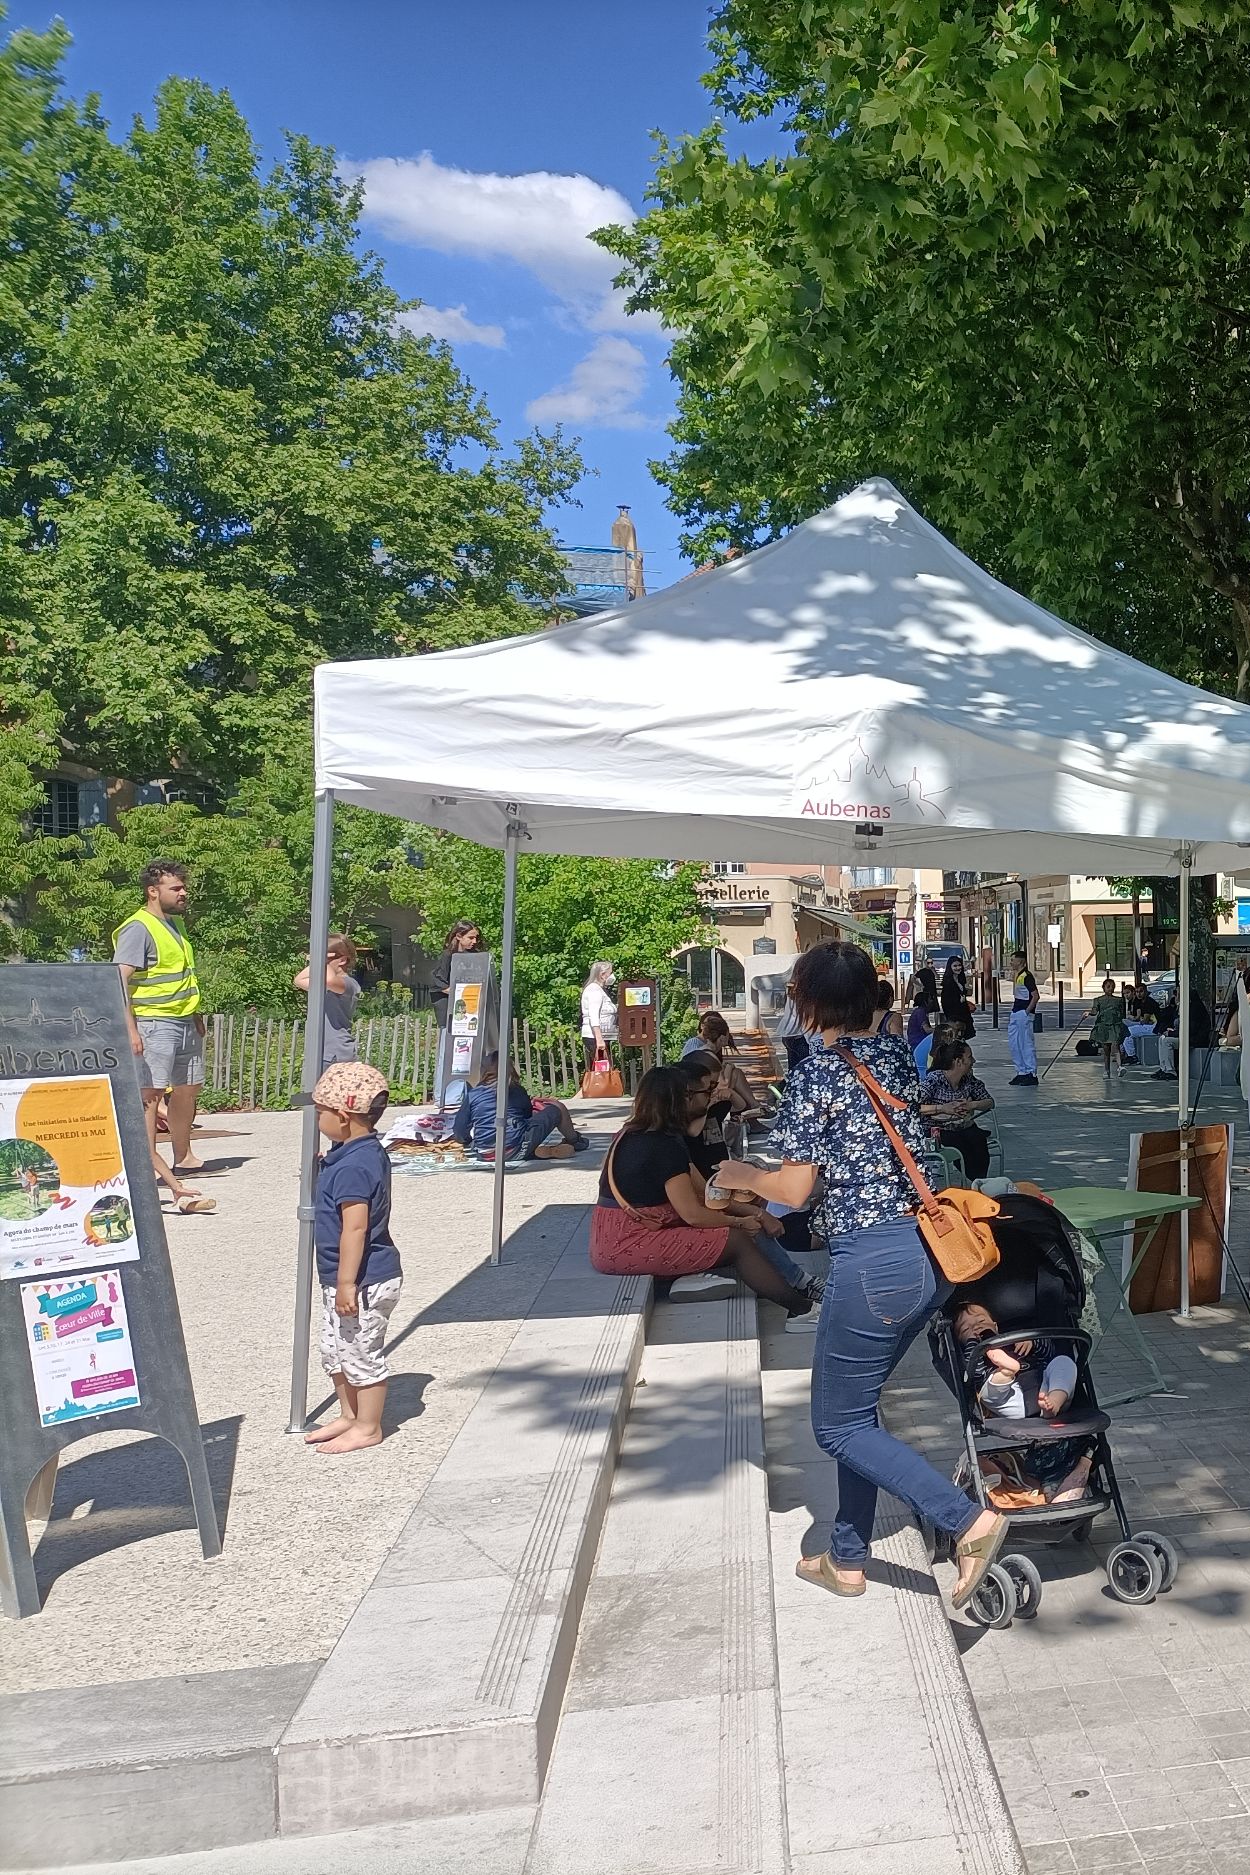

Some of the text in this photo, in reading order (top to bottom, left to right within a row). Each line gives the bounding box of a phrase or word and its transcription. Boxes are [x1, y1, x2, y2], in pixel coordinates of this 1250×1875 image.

[801, 798, 891, 819] Aubenas
[37, 1117, 67, 1126] initiation
[80, 1114, 107, 1123] Slackline
[35, 1128, 106, 1142] MERCREDI 11 MAI
[4, 1229, 23, 1237] Agora
[33, 1225, 53, 1233] champ
[56, 1292, 87, 1309] AGENDA
[77, 1314, 88, 1324] de
[87, 1308, 106, 1320] Ville
